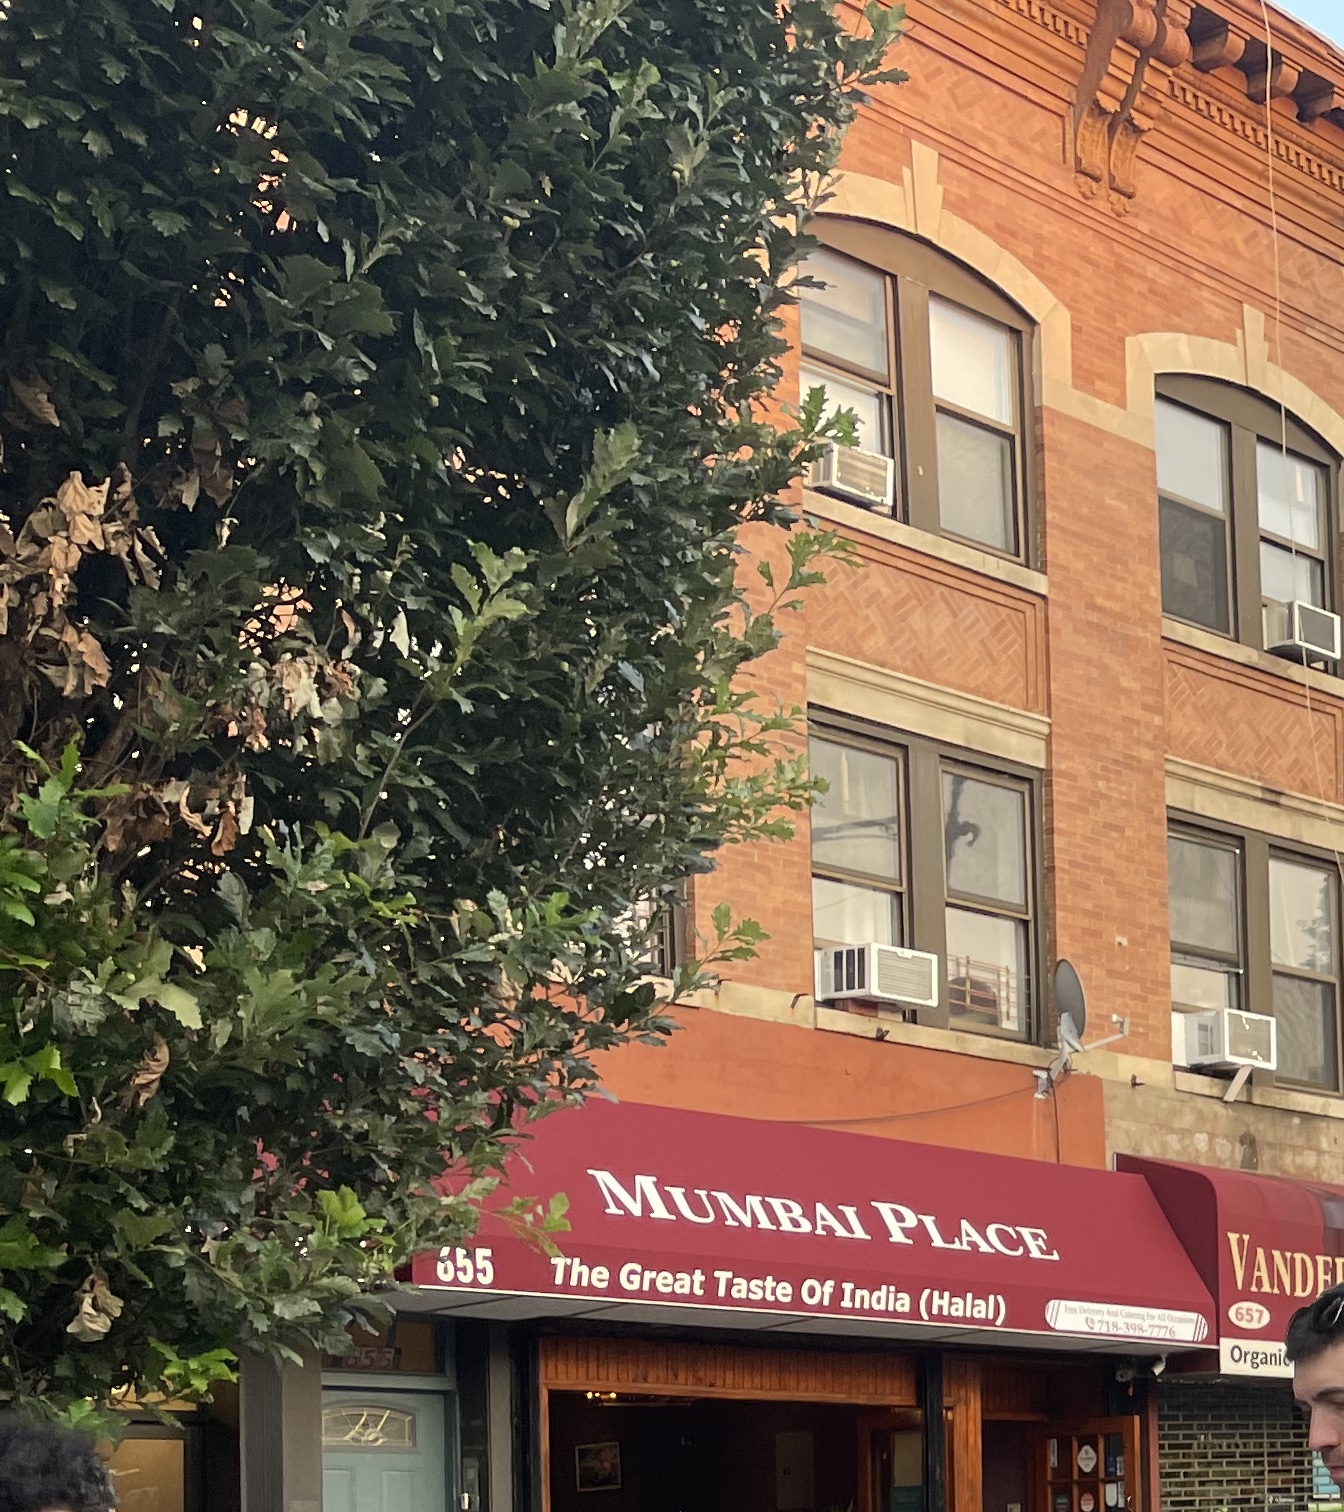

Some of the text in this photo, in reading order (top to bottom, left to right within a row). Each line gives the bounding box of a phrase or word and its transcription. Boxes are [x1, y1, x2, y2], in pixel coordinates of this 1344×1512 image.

[586, 1167, 1060, 1261] MUMBAI PLACE
[436, 1246, 494, 1285] 655
[550, 1256, 1008, 1327] The Great Taste Of India (Halal)
[1097, 1319, 1176, 1337] 718-398-7776
[1234, 1307, 1264, 1324] 657
[1230, 1344, 1291, 1369] Organic
